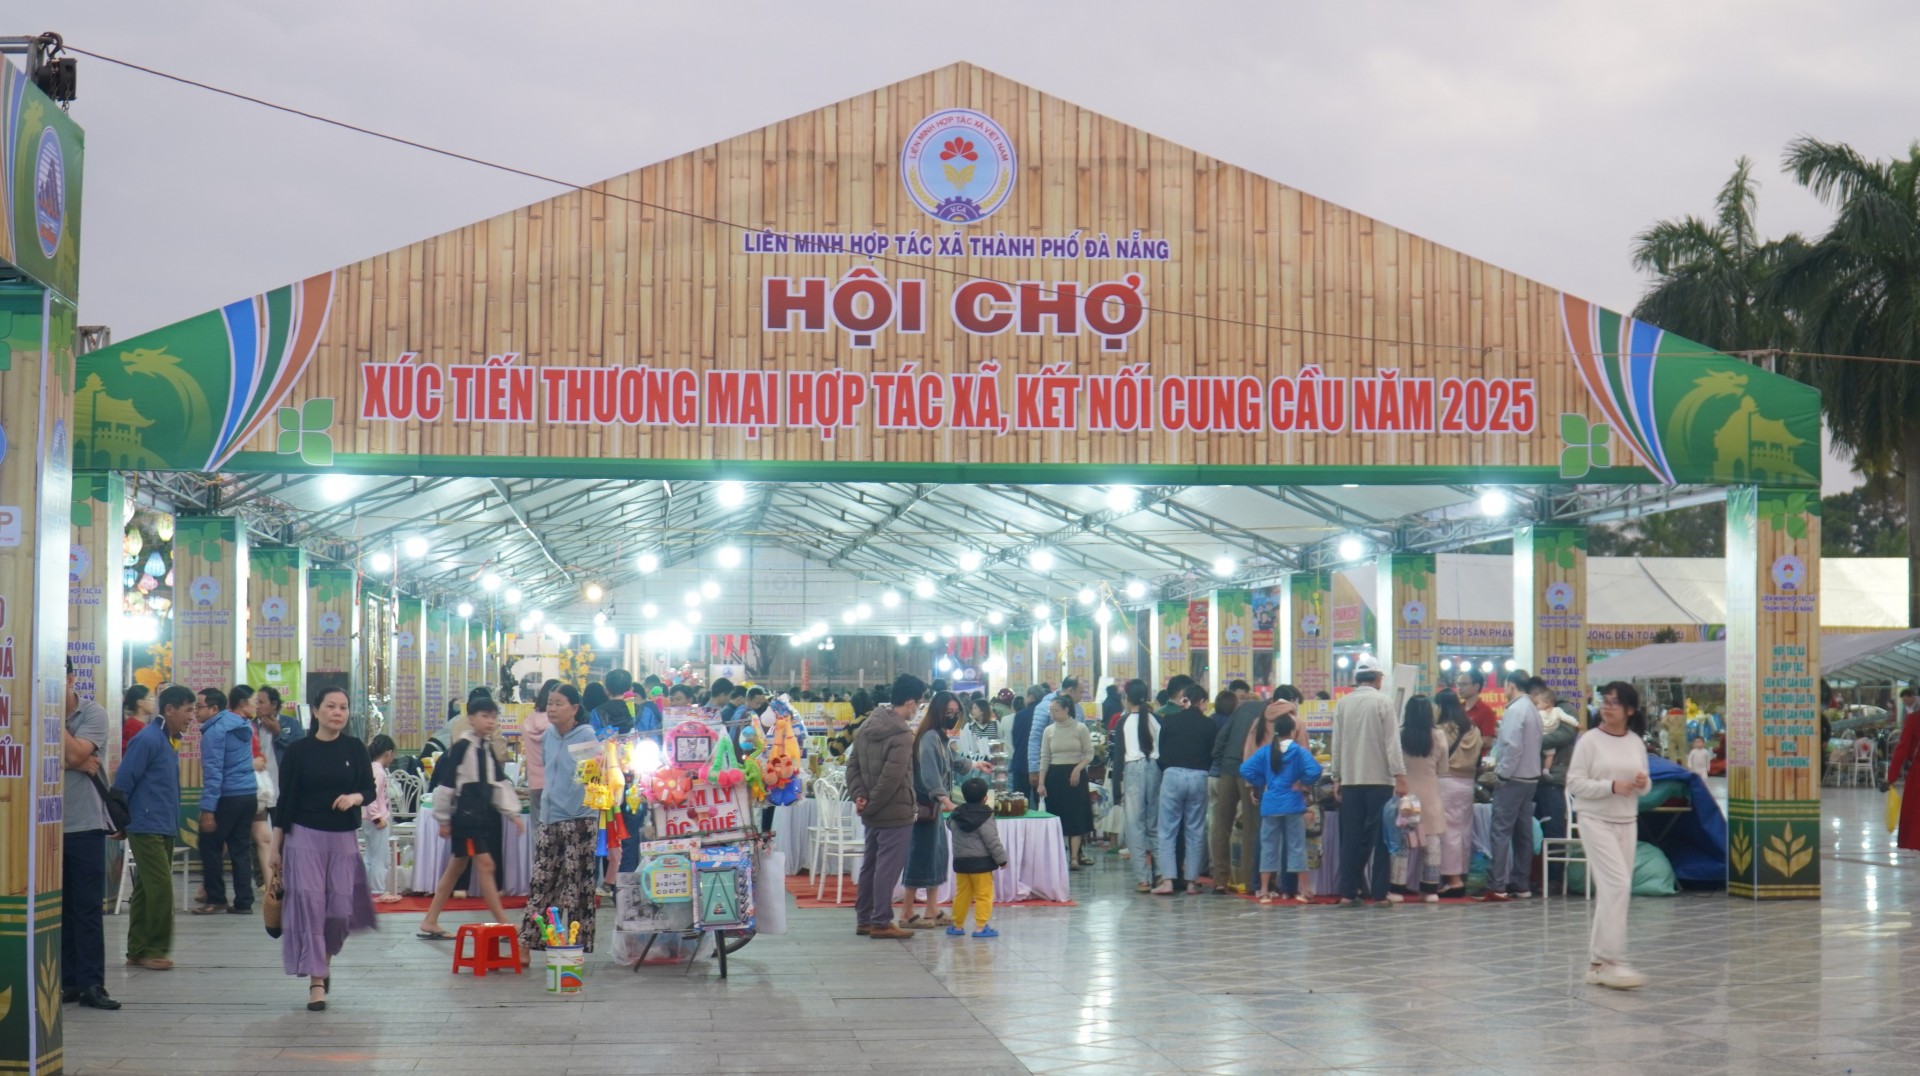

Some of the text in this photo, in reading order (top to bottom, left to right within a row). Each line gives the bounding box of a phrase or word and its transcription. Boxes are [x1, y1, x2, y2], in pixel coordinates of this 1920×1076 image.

[918, 124, 936, 142] MINH
[997, 143, 1009, 162] NAM
[949, 205, 967, 214] VCA
[744, 229, 1169, 260] LIÊN MINH HỢP TÁC XÃ THÀNH PHỐ ĐÀ NẴNG
[767, 267, 1144, 351] HỘI CHỢ
[362, 354, 1534, 438] XÚC TIẾN THƯƠNG MẠI HỢP TÁC XÃ, KẾT NỐI CUNG CẦU NĂM 2025
[1440, 626, 1465, 636] OCOP
